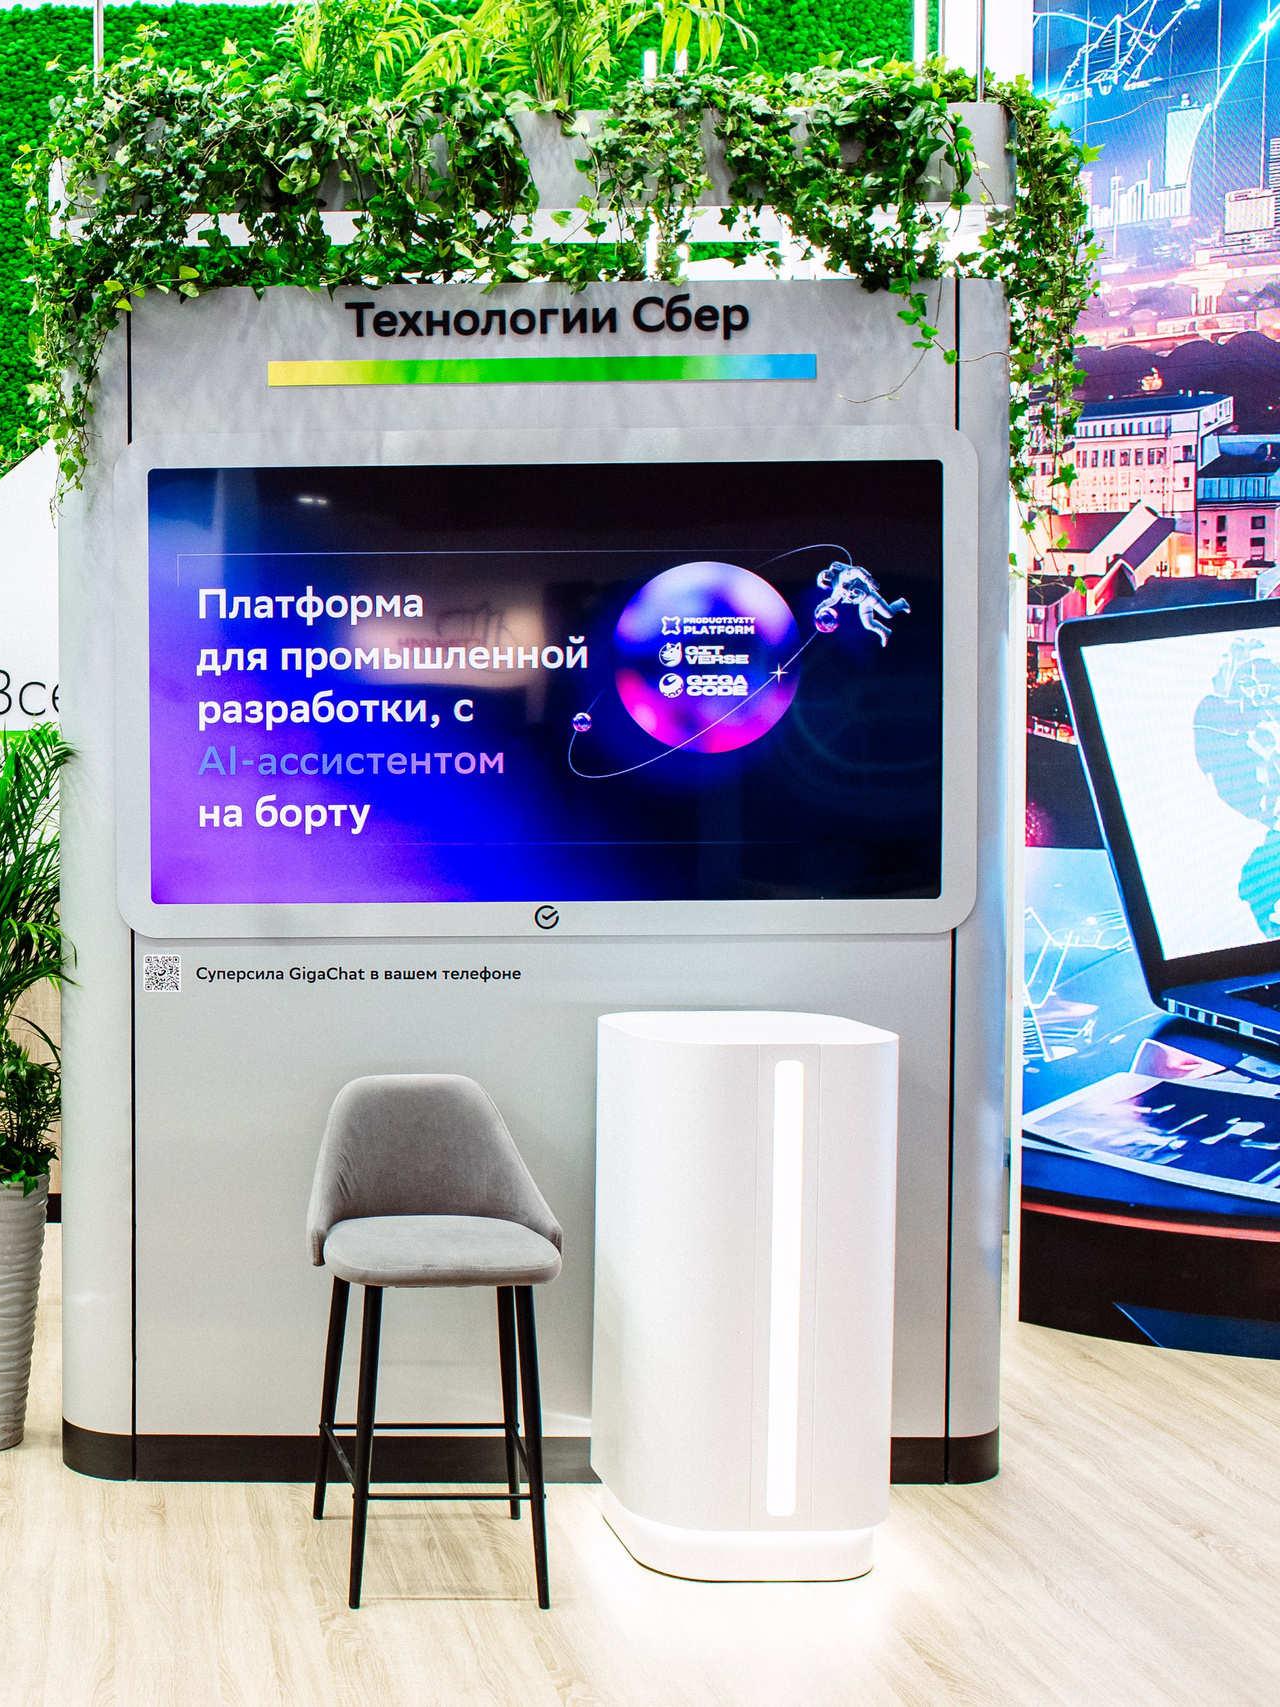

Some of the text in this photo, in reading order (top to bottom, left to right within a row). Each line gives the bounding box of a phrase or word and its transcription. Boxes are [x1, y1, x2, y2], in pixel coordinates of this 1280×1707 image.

[344, 293, 750, 340] Технологии Сбер
[197, 585, 424, 627] Платформа
[683, 625, 755, 635] PLATFORM
[196, 636, 588, 678] для промышленной
[685, 645, 725, 655] GIT
[685, 655, 749, 665] VERSE
[686, 675, 748, 686] GIGA
[686, 685, 748, 696] CODE
[198, 690, 474, 732] разработки, с
[198, 746, 505, 776] AI-ассистентом
[198, 795, 371, 835] на борту
[196, 966, 522, 983] Суперсила GigaChat в вашем телефоне
